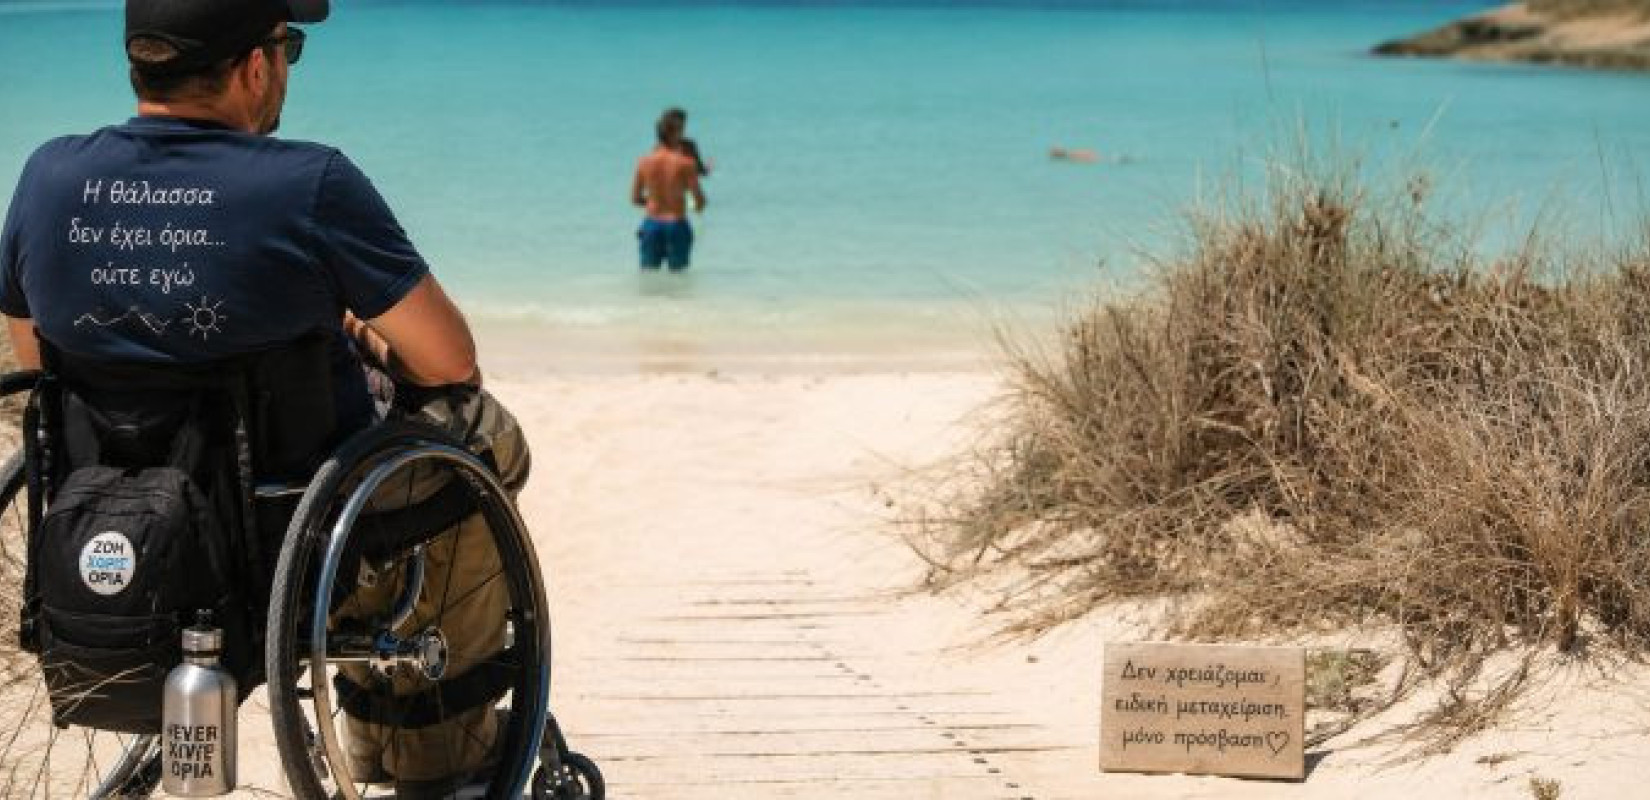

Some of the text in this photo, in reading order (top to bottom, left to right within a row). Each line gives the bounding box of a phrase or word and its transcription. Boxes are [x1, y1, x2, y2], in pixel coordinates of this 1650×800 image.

[110, 180, 214, 205] θάλασσα
[69, 217, 104, 243] δεν
[110, 222, 152, 250] έχει
[90, 261, 195, 294] ούτε εγώ
[1121, 660, 1156, 681] Δεν
[1122, 727, 1264, 754] μόνο πρόσβαση
